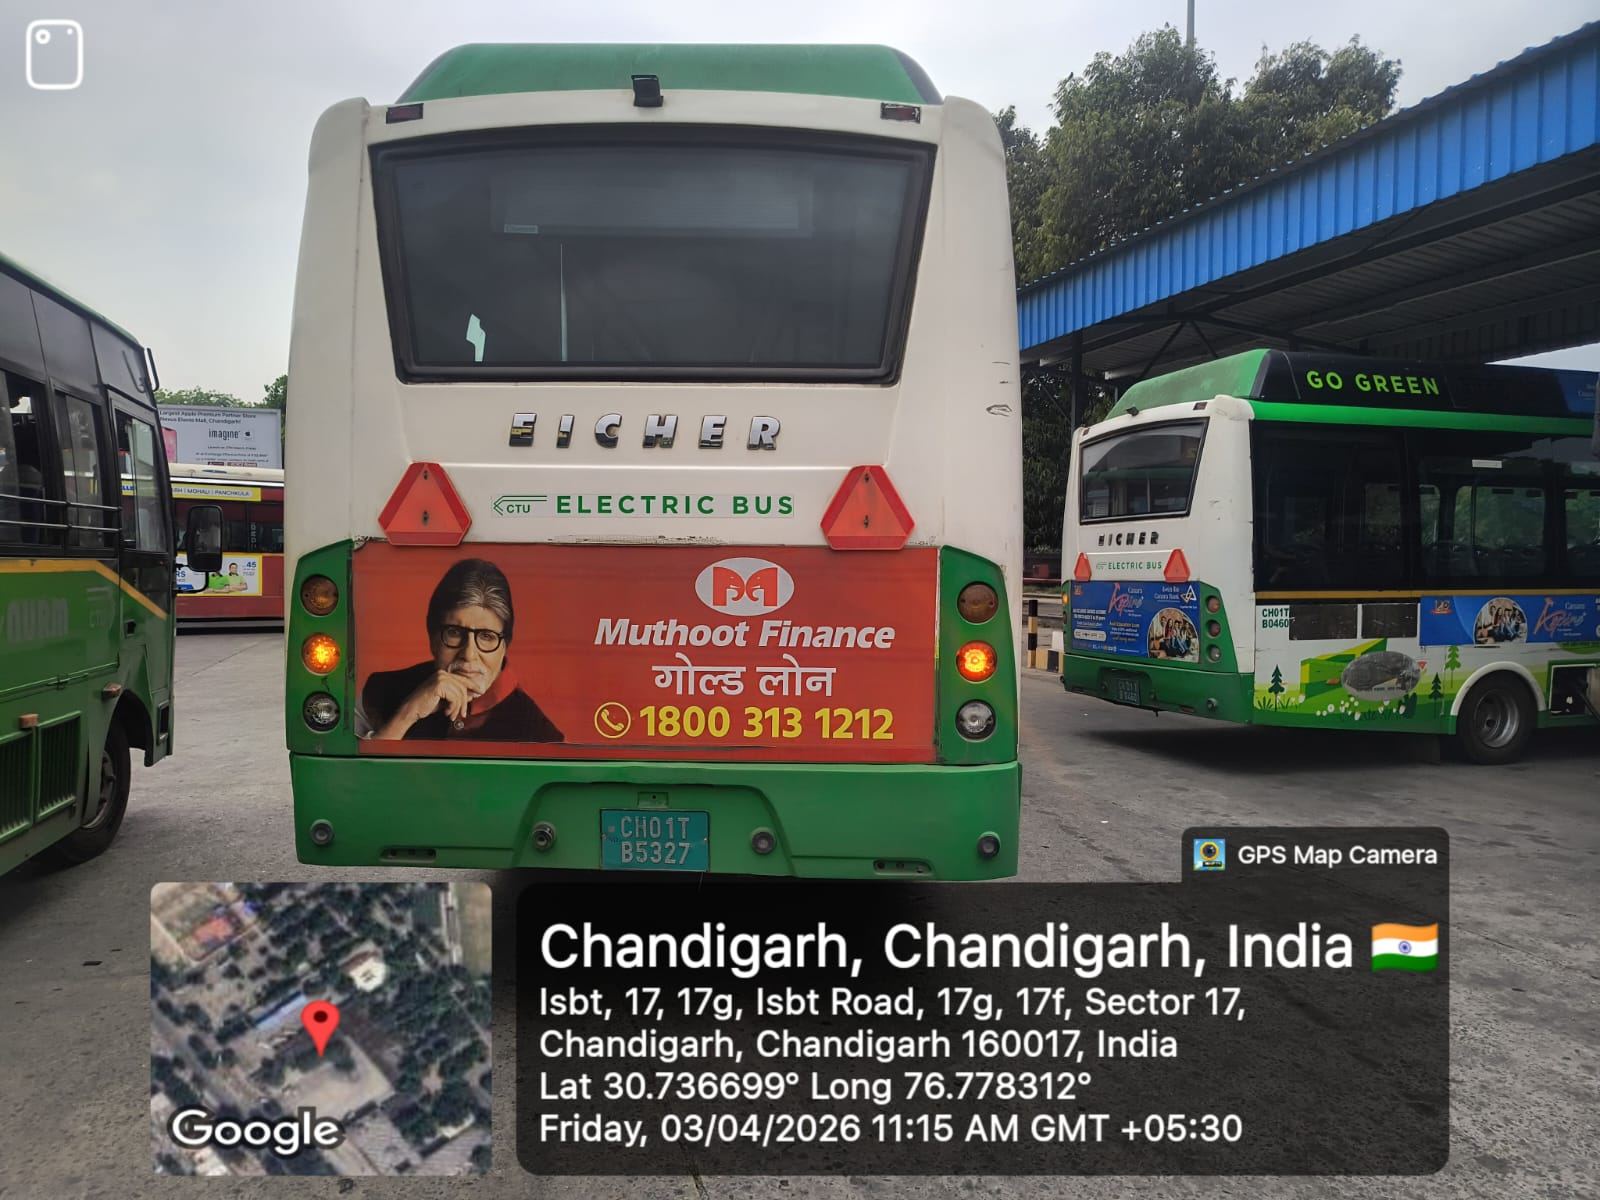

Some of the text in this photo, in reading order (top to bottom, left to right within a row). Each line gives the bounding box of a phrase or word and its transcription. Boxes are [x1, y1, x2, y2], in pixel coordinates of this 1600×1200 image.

[1306, 370, 1439, 395] GO GREEN
[209, 428, 239, 441] imagine
[509, 412, 781, 450] EICHER
[214, 489, 250, 497] PANCHKULA
[506, 503, 531, 514] CTU
[556, 495, 793, 514] ELECTRIC BUS
[1108, 562, 1143, 570] ELECTRIC
[1147, 561, 1162, 570] BUS
[1262, 608, 1290, 618] CH01T
[594, 617, 897, 649] Muthoot Finance
[1262, 619, 1289, 629] B0460
[652, 652, 837, 697] गोल्ड लोन
[639, 705, 894, 740] 1800 313 1212
[621, 816, 690, 839] CH01T
[621, 841, 690, 865] B5327
